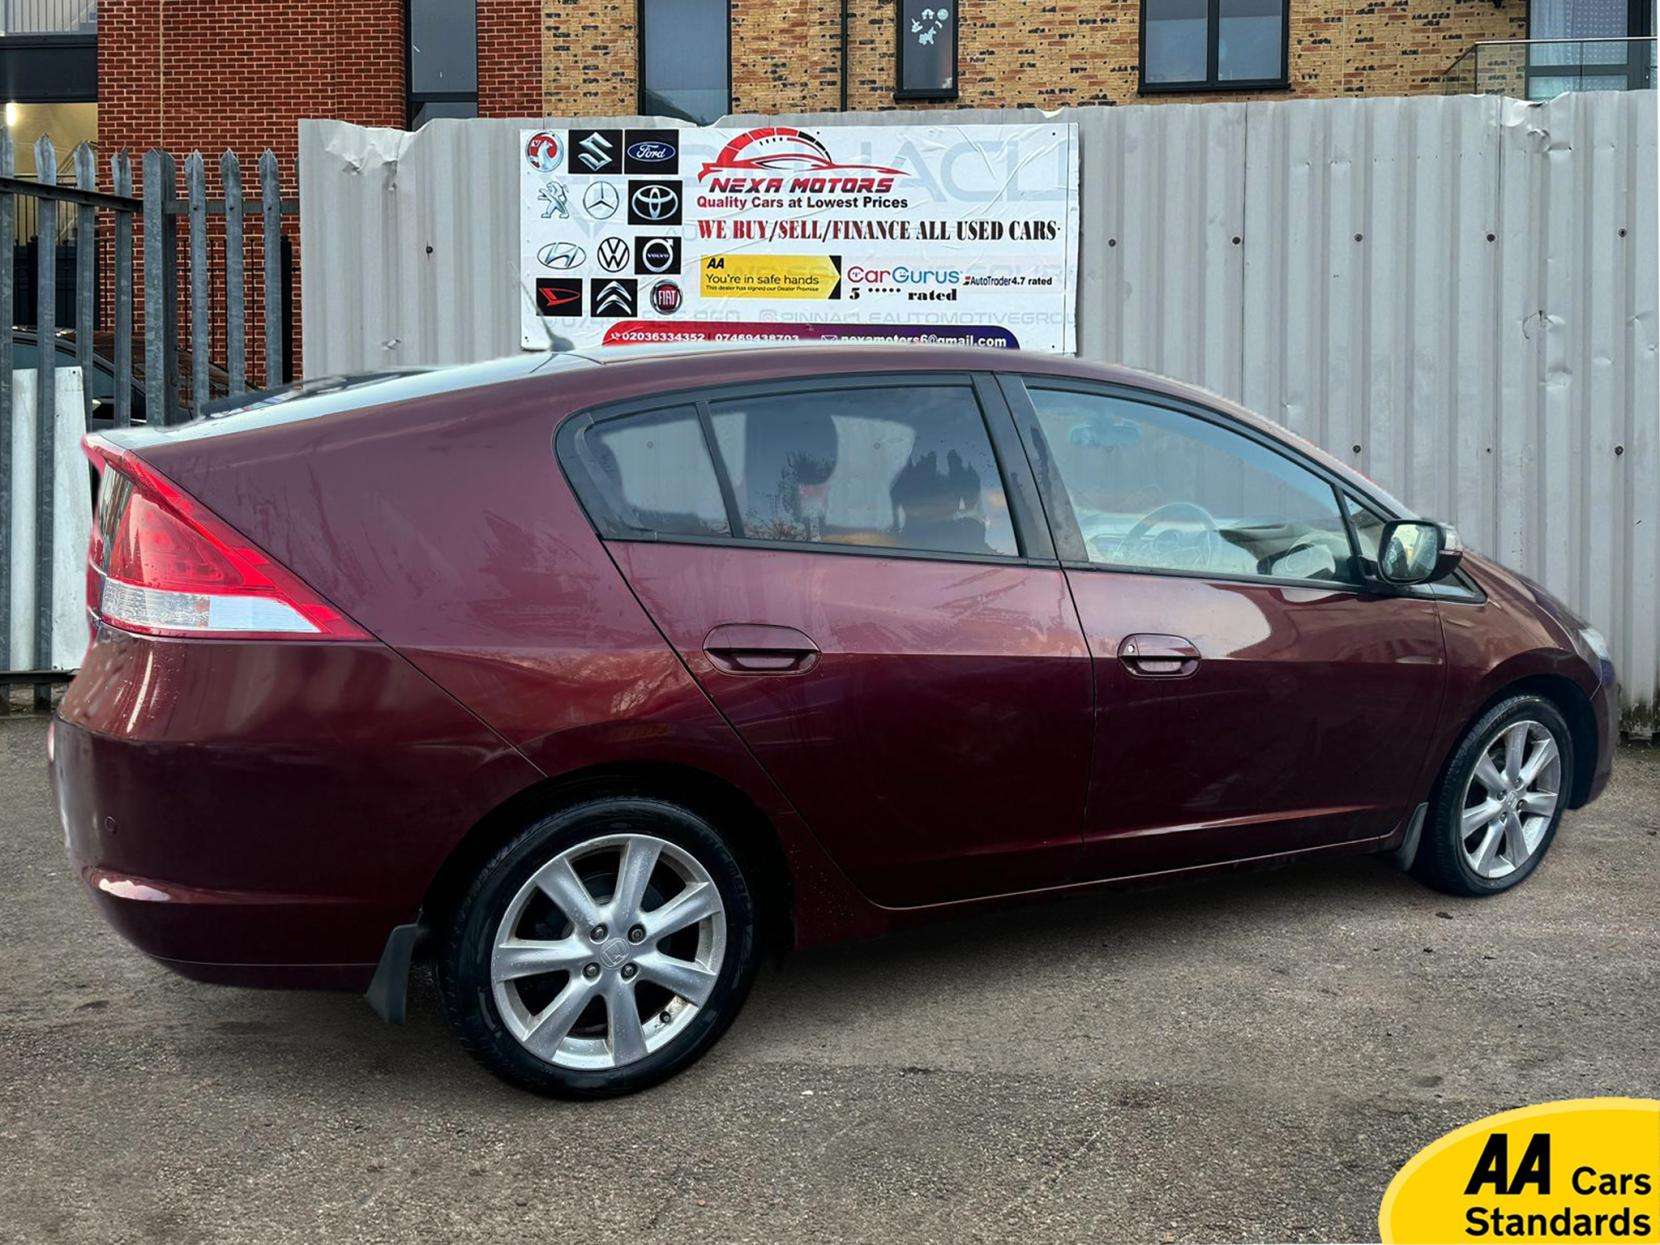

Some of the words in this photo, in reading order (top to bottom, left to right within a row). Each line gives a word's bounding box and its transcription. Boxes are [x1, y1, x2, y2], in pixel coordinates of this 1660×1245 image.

[636, 143, 665, 159] Ford
[709, 177, 784, 194] NEXA
[789, 177, 894, 194] MOTORS
[697, 195, 750, 211] Quality
[752, 196, 784, 208] Cars
[788, 197, 803, 208] at
[807, 196, 858, 208] Lowest
[864, 197, 908, 208] Prices
[697, 219, 727, 240] WE
[915, 220, 951, 240] ALL
[956, 220, 1004, 240] USED
[1008, 219, 1057, 241] CARS
[707, 257, 725, 269] AA
[706, 273, 741, 284] You're
[744, 273, 754, 284] in
[757, 273, 781, 285] safe
[784, 274, 819, 285] hands
[847, 265, 960, 284] CarGurus
[1028, 276, 1053, 286] rated
[658, 290, 677, 306] FIAT
[849, 287, 860, 300] 5
[908, 288, 957, 301] rated
